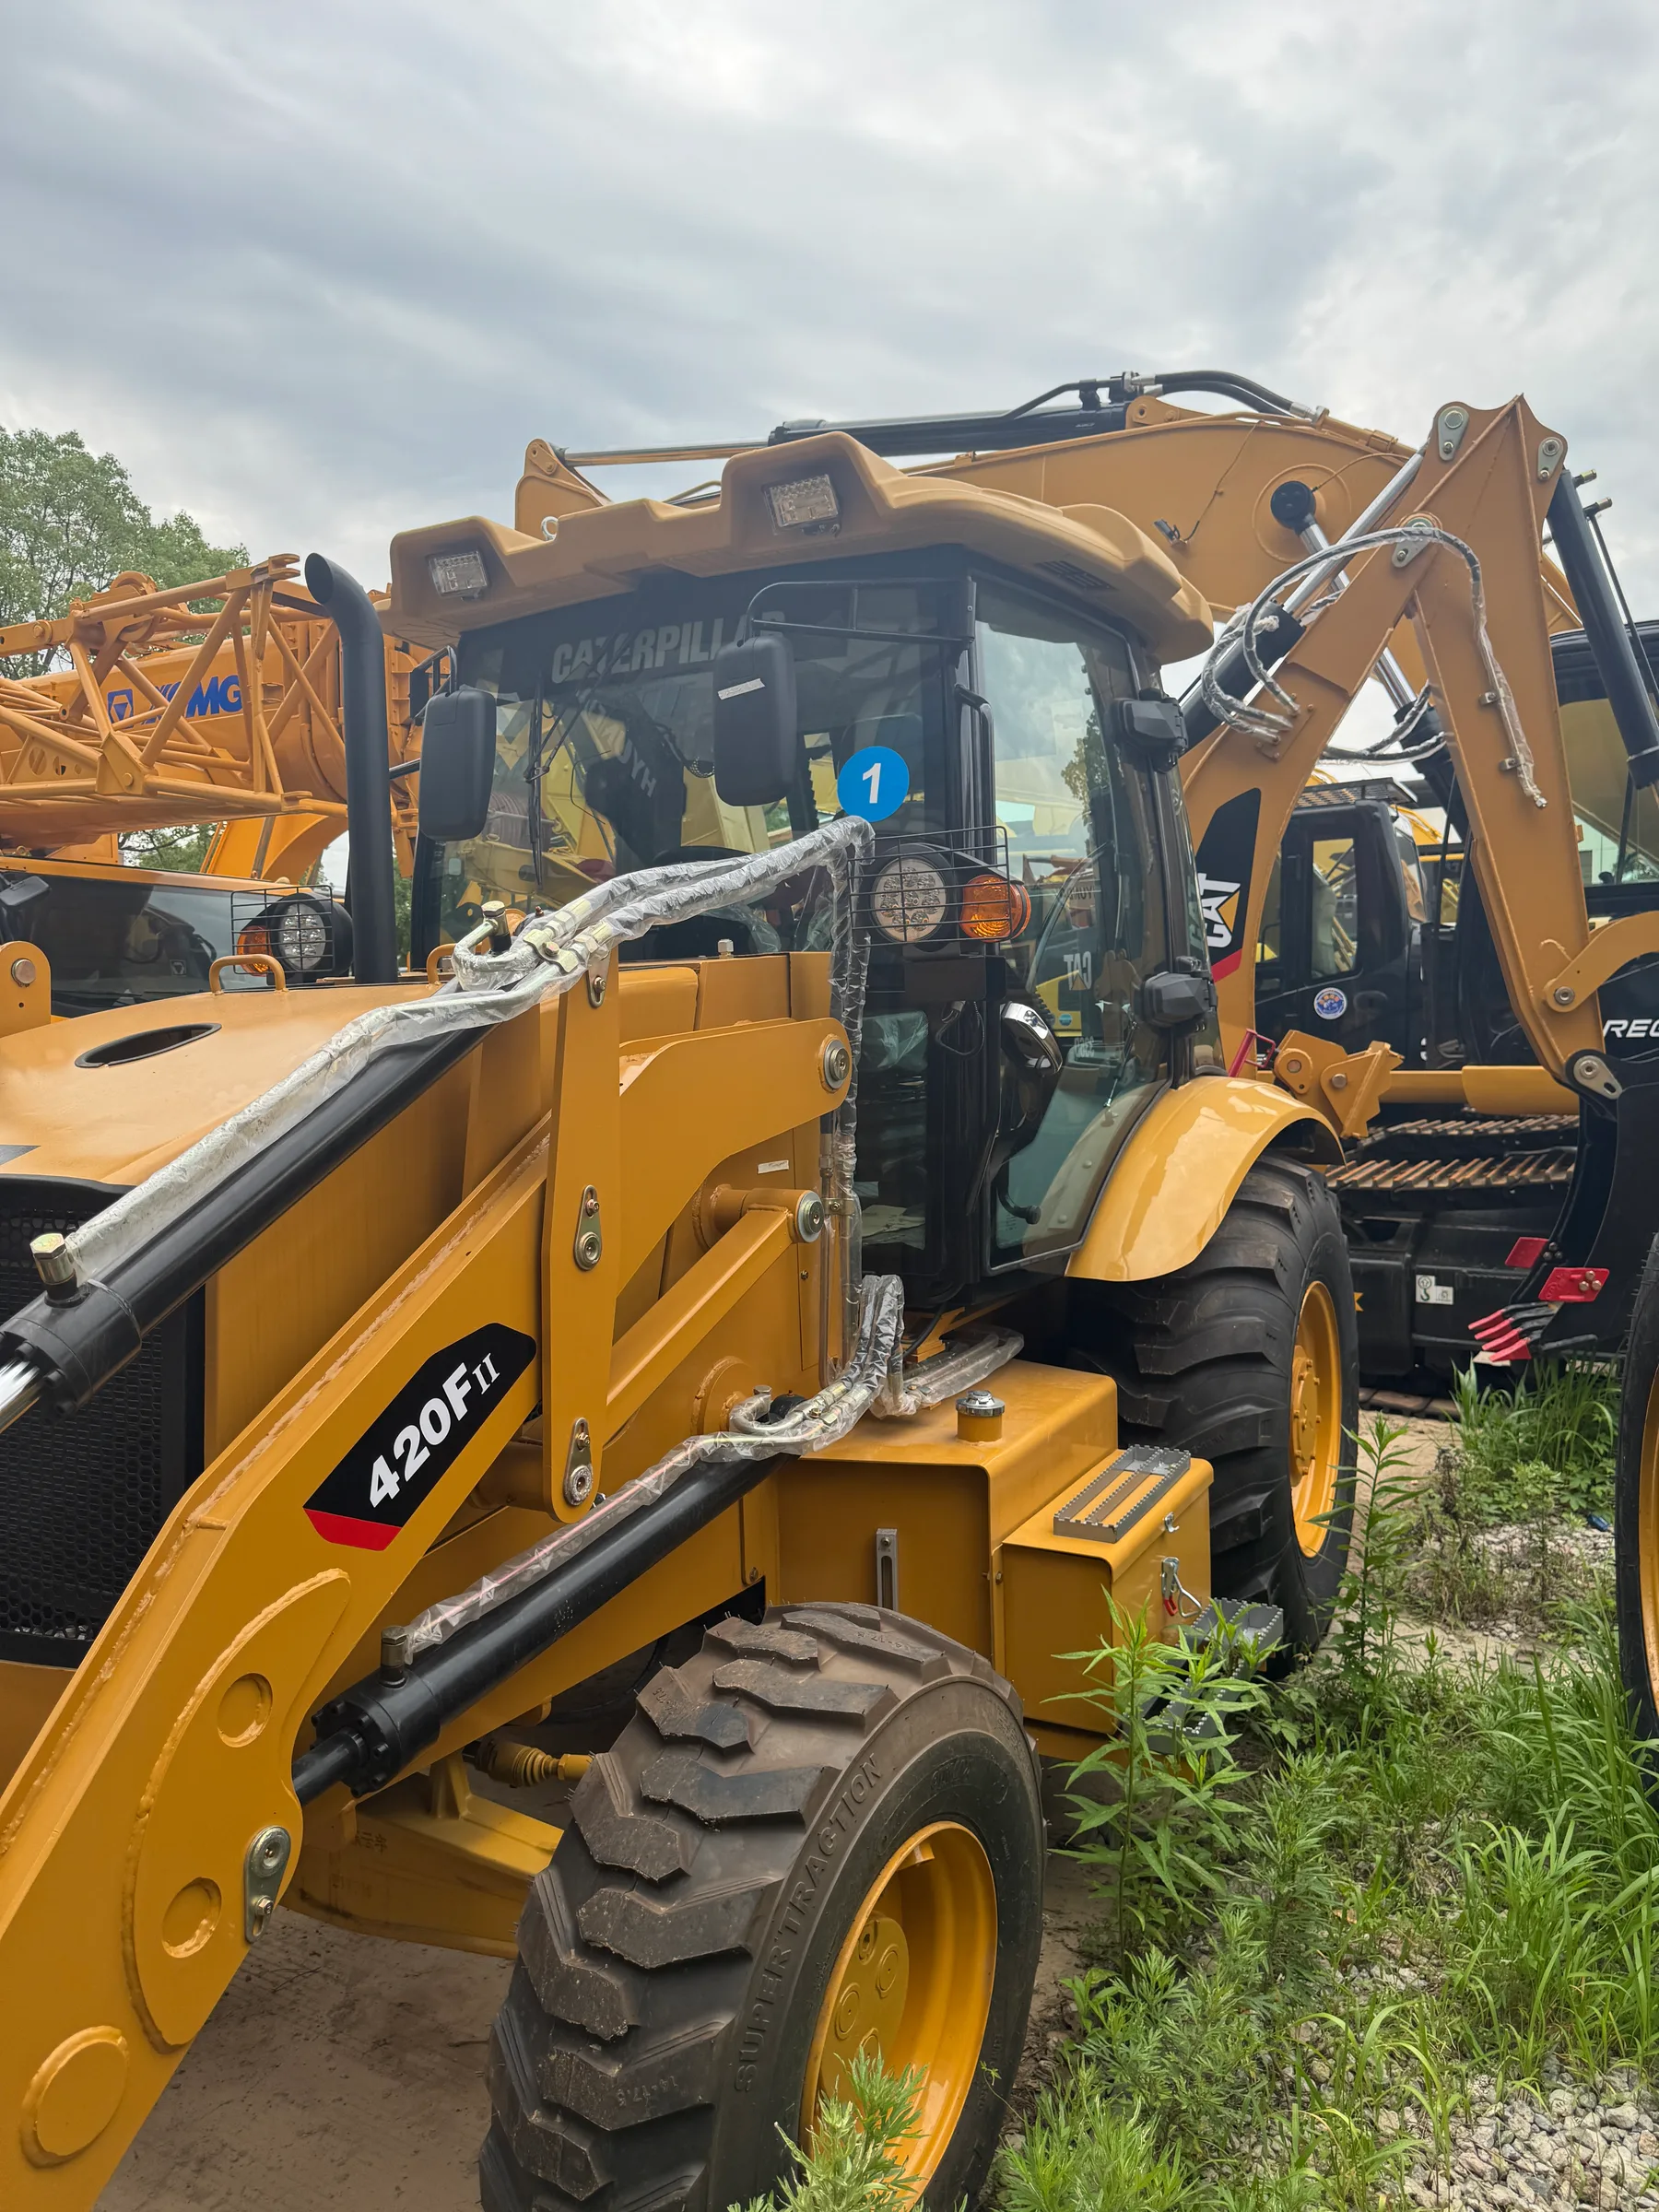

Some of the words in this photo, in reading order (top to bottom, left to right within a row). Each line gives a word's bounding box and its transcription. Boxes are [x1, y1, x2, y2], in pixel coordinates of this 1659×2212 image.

[862, 762, 882, 805] 1
[1197, 872, 1241, 949] CAT
[370, 1362, 472, 1508] 420F
[472, 1352, 500, 1395] II
[734, 1947, 792, 2094] SUPER
[776, 1752, 884, 1936] TRACTION
